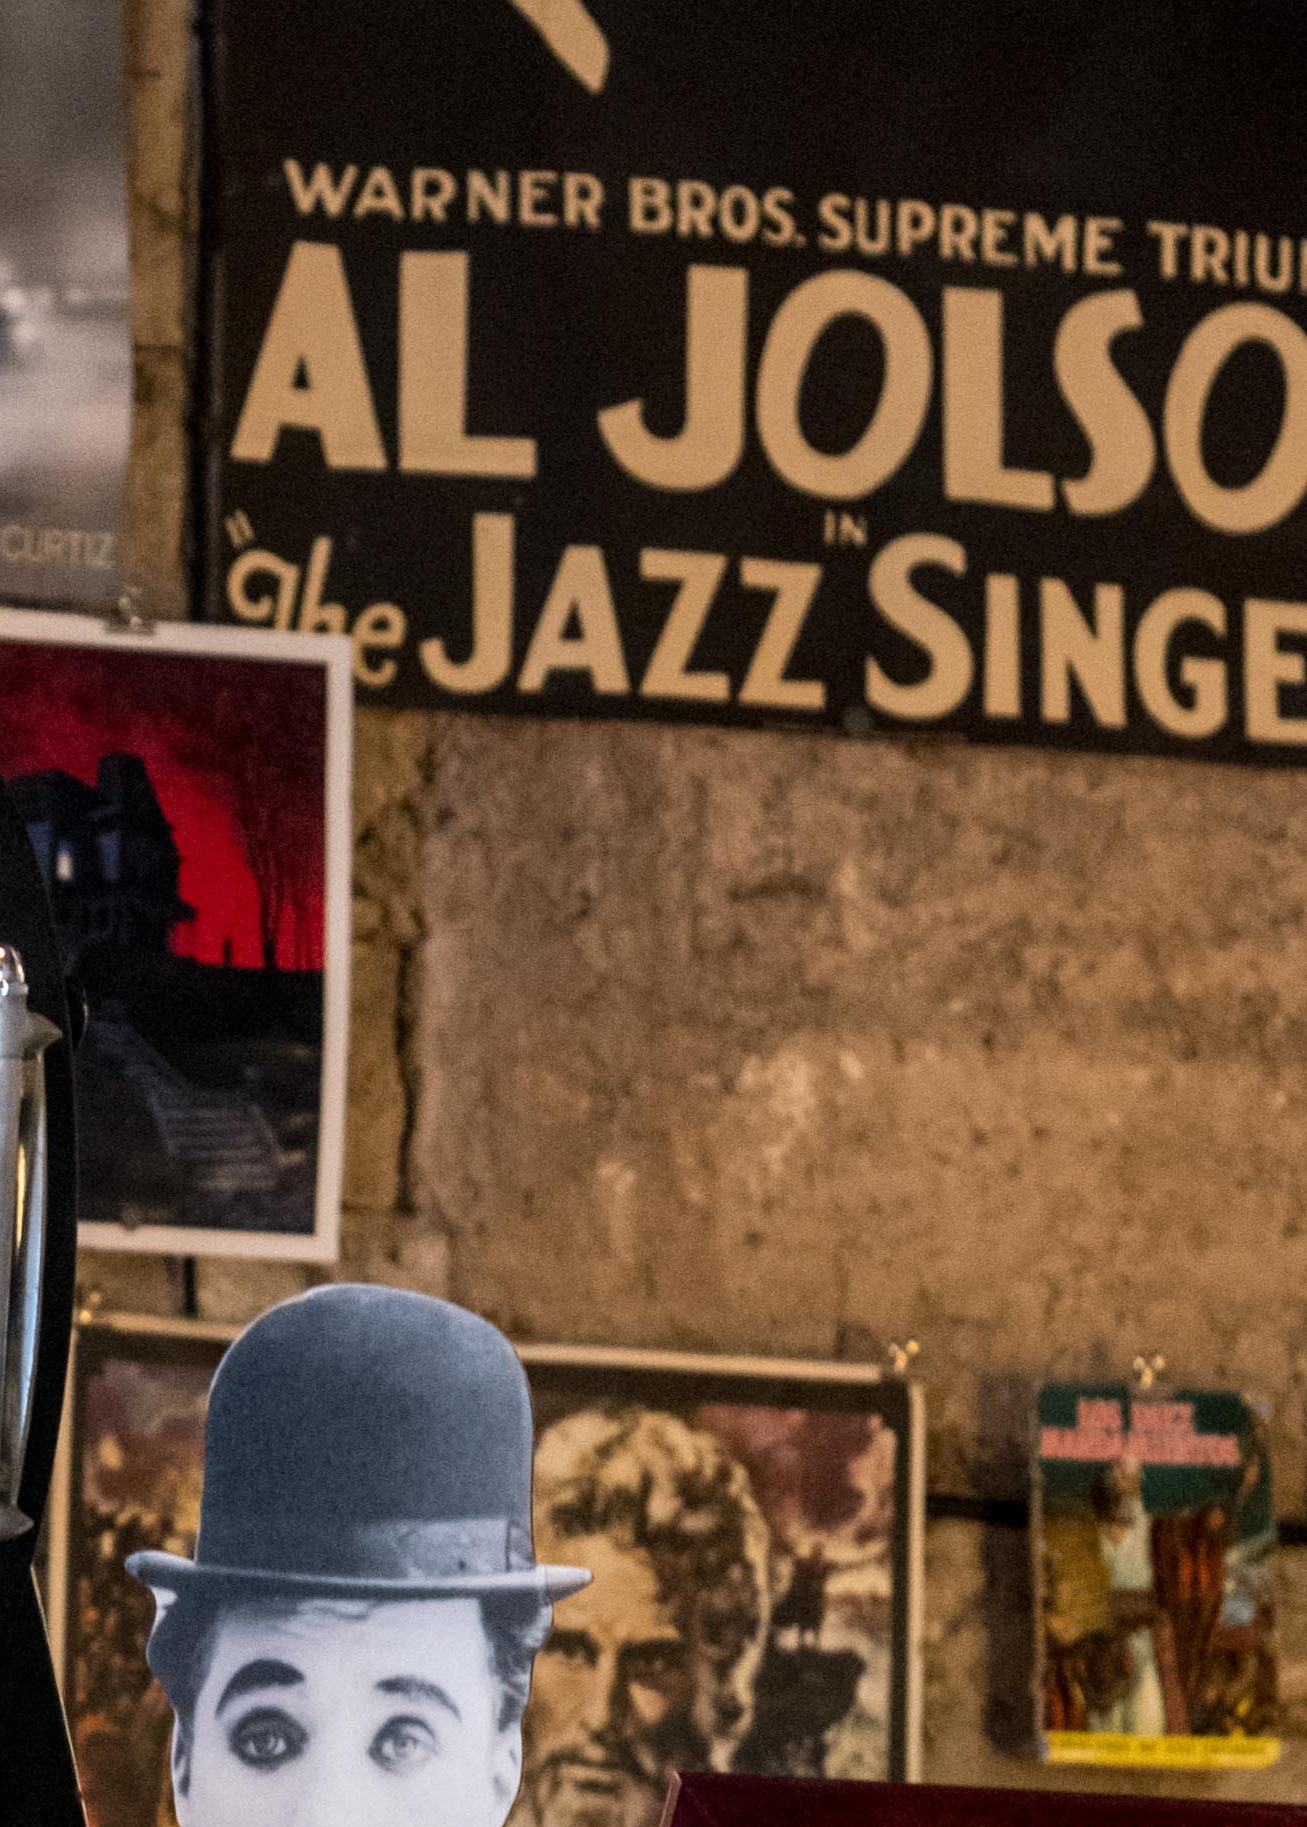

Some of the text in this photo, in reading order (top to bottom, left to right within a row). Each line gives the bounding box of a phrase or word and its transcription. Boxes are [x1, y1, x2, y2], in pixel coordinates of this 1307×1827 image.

[284, 158, 1307, 297] WARNER BROS. SUPREME TRIU
[230, 239, 1307, 536] AL JOLSO
[823, 509, 867, 549] IN
[420, 512, 826, 712] JAZZ
[865, 532, 1307, 746] SINGE
